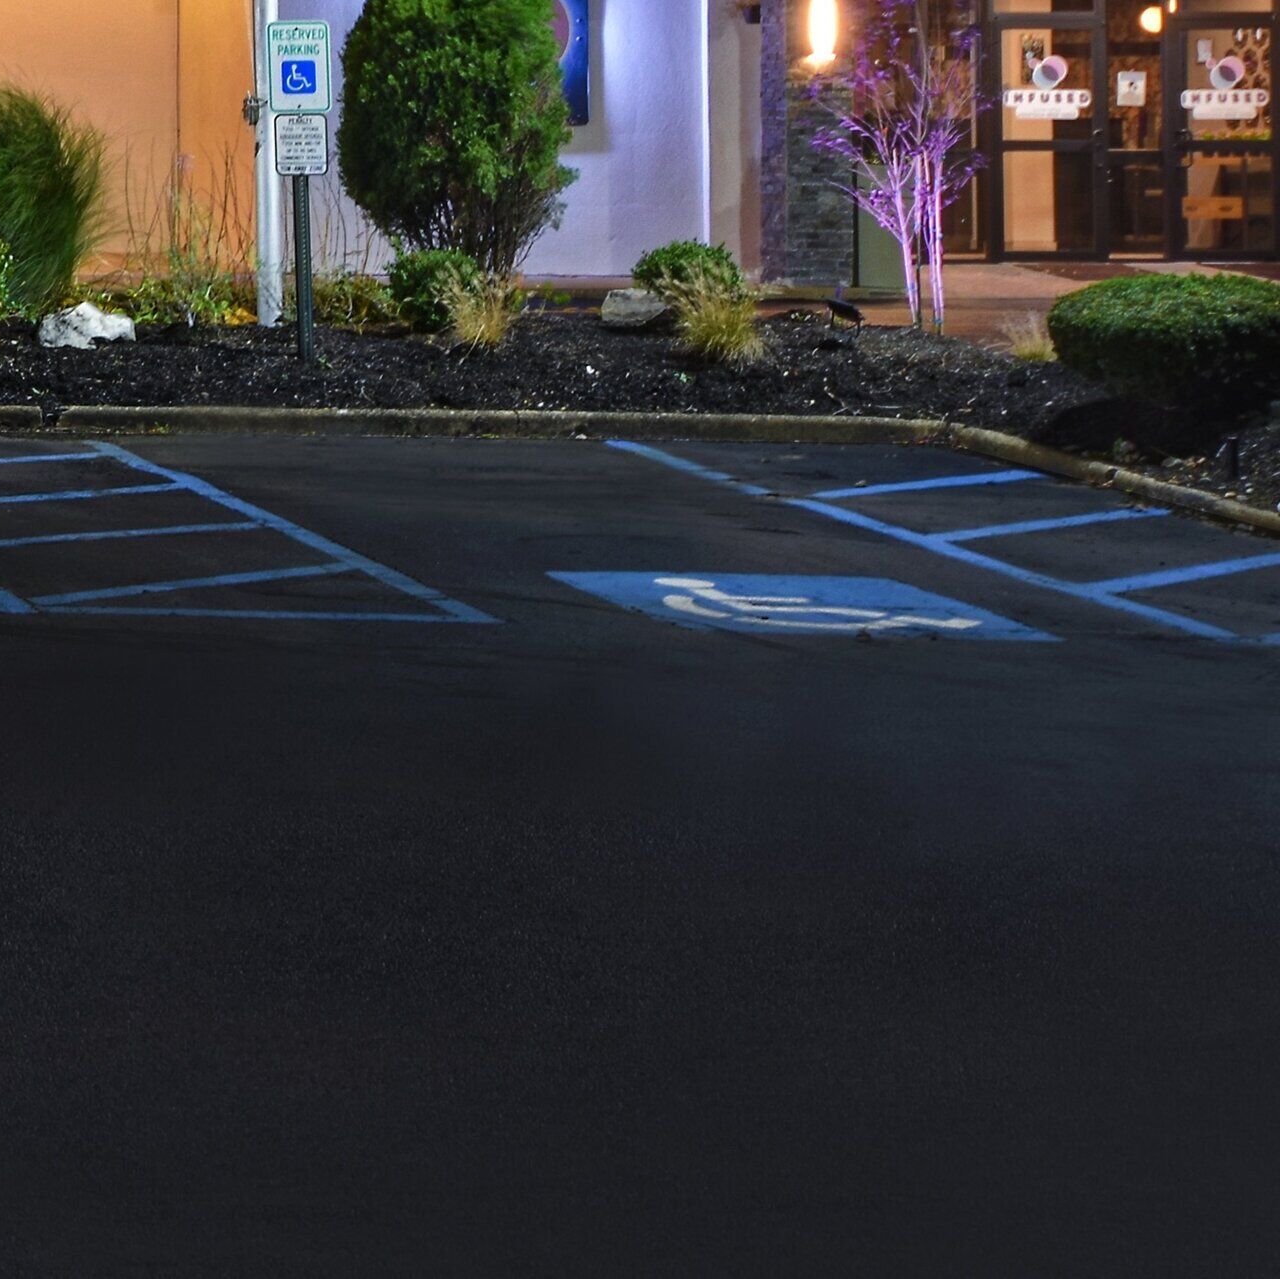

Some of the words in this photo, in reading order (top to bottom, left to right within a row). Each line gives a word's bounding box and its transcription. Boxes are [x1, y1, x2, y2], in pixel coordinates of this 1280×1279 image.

[272, 28, 325, 40] RESERVED
[277, 44, 320, 56] PARKING
[1004, 93, 1089, 103] INFUSED
[1182, 92, 1266, 103] INFUSED
